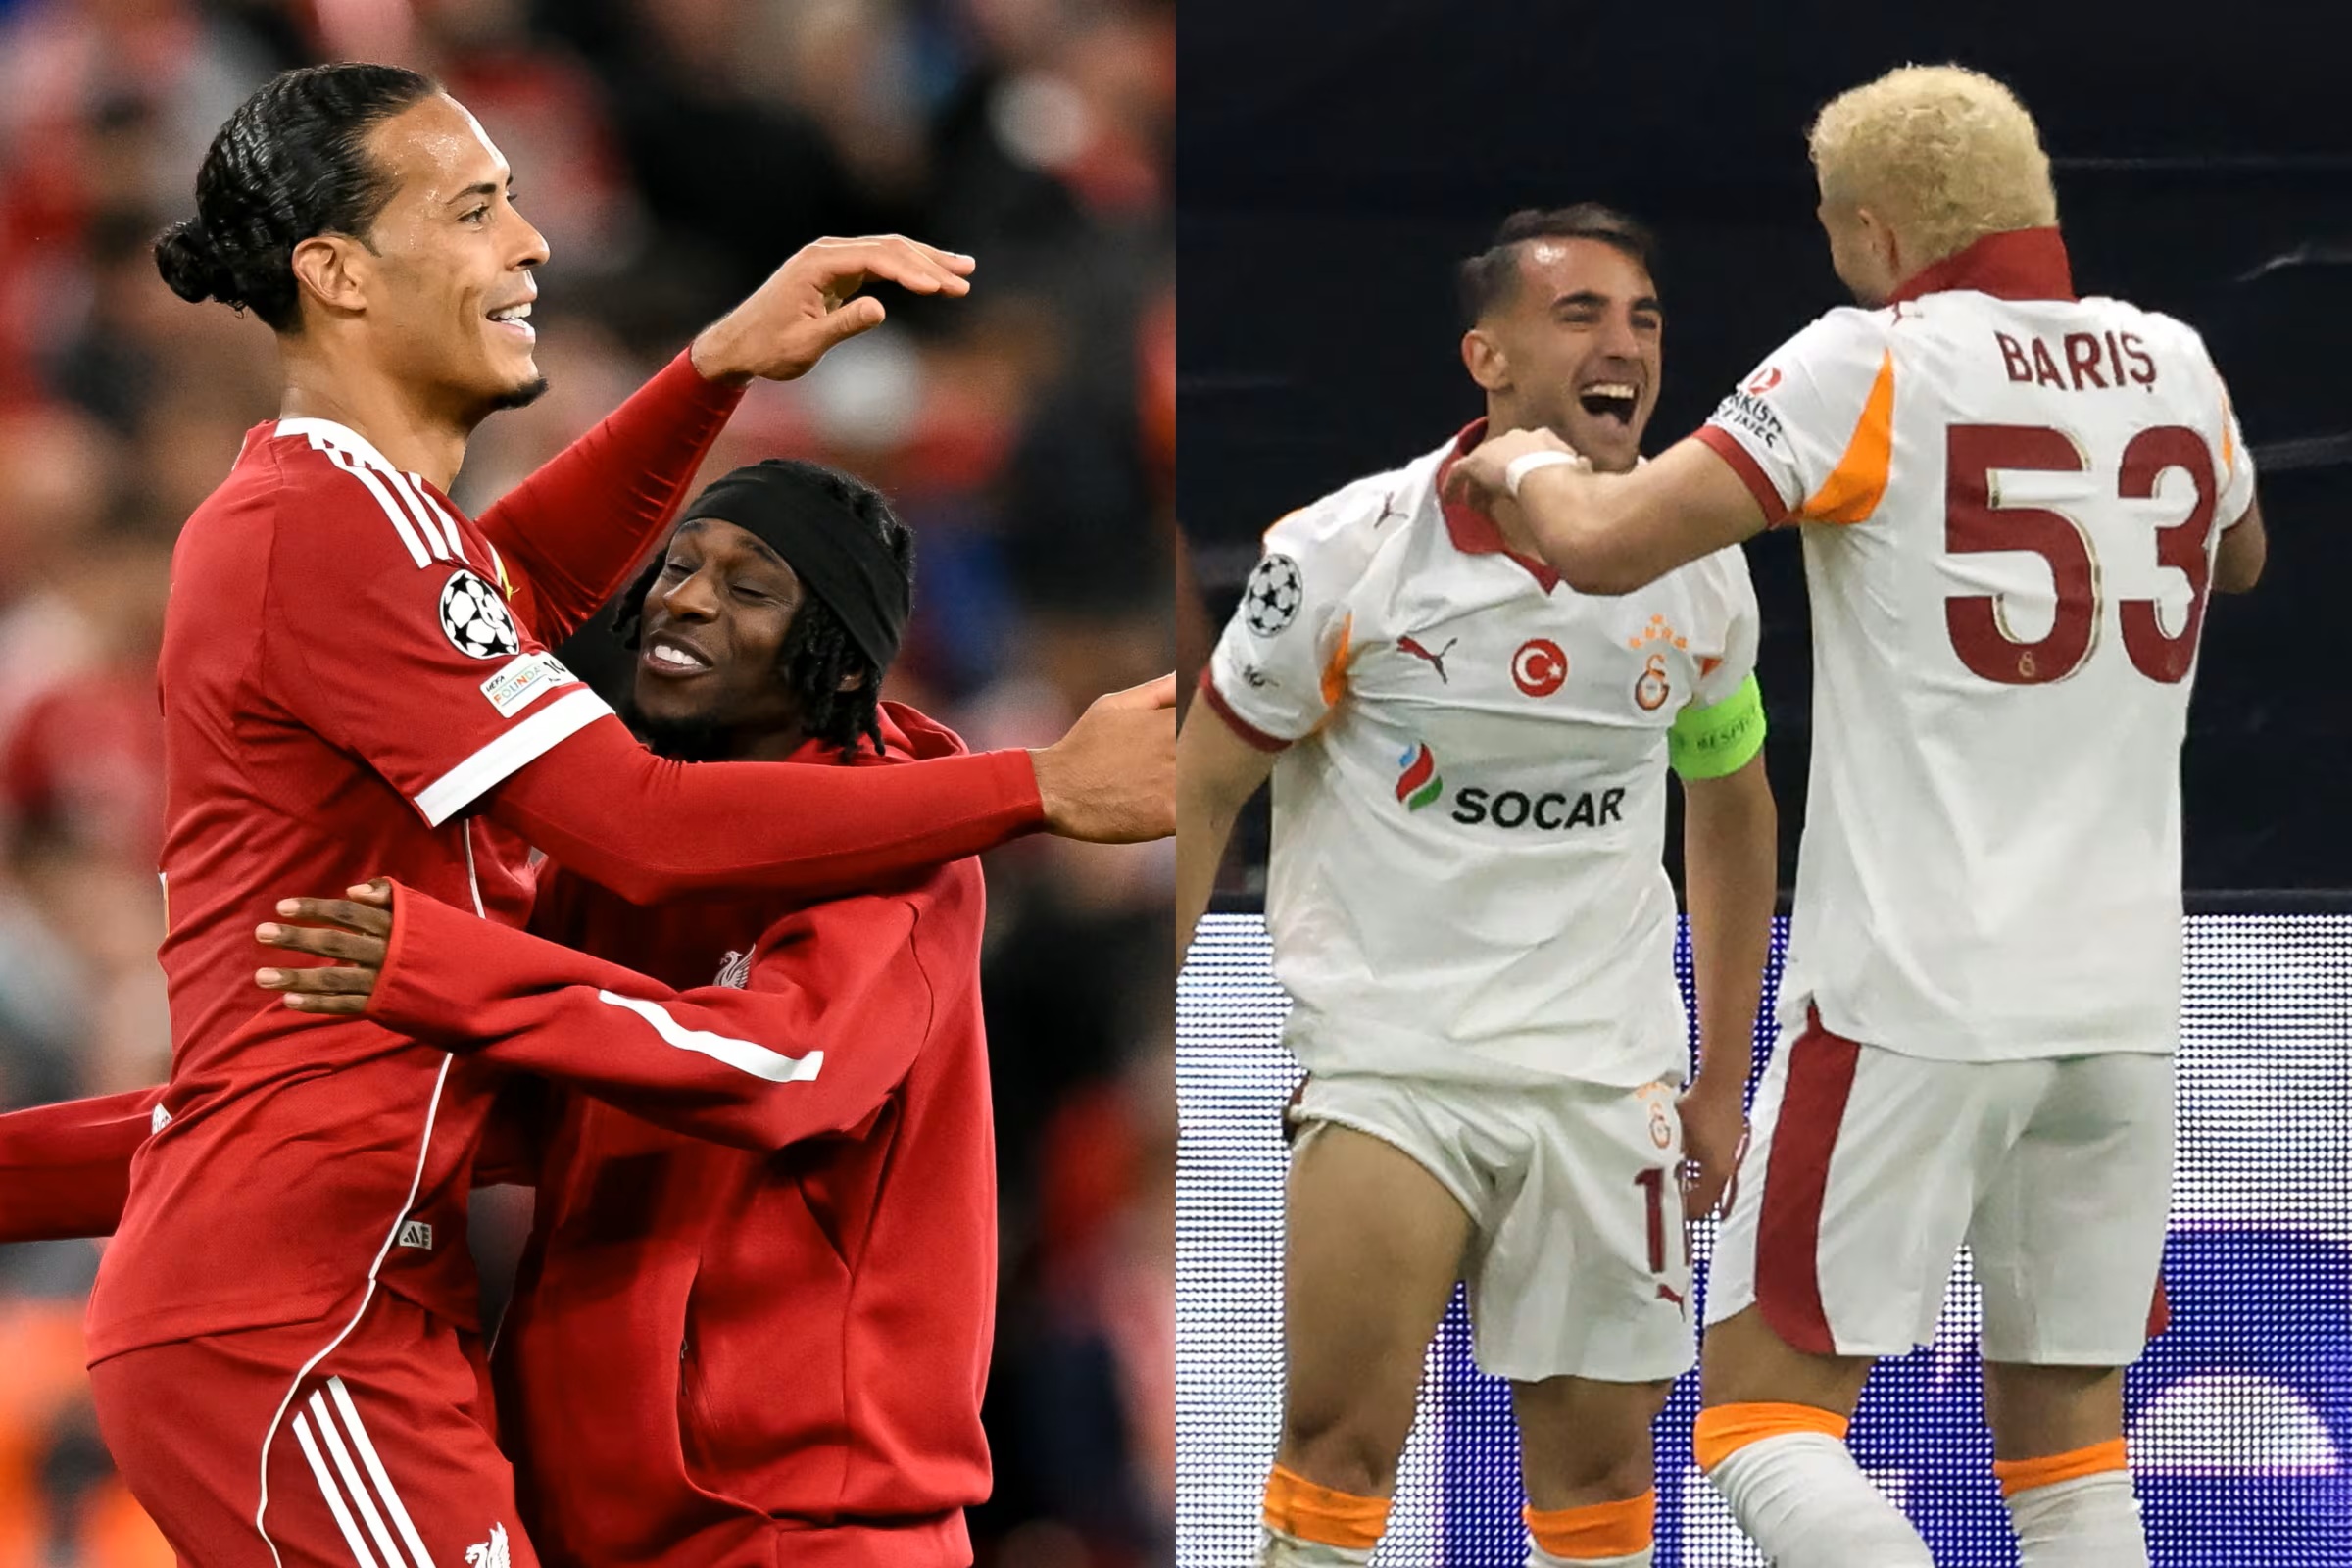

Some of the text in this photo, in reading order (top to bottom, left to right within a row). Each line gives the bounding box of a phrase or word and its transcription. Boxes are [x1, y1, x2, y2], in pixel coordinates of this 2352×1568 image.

[1995, 331, 2157, 392] BARIŞ
[1945, 423, 2217, 685] 53
[486, 674, 506, 692] UEFA
[1451, 787, 1625, 830] SOCAR
